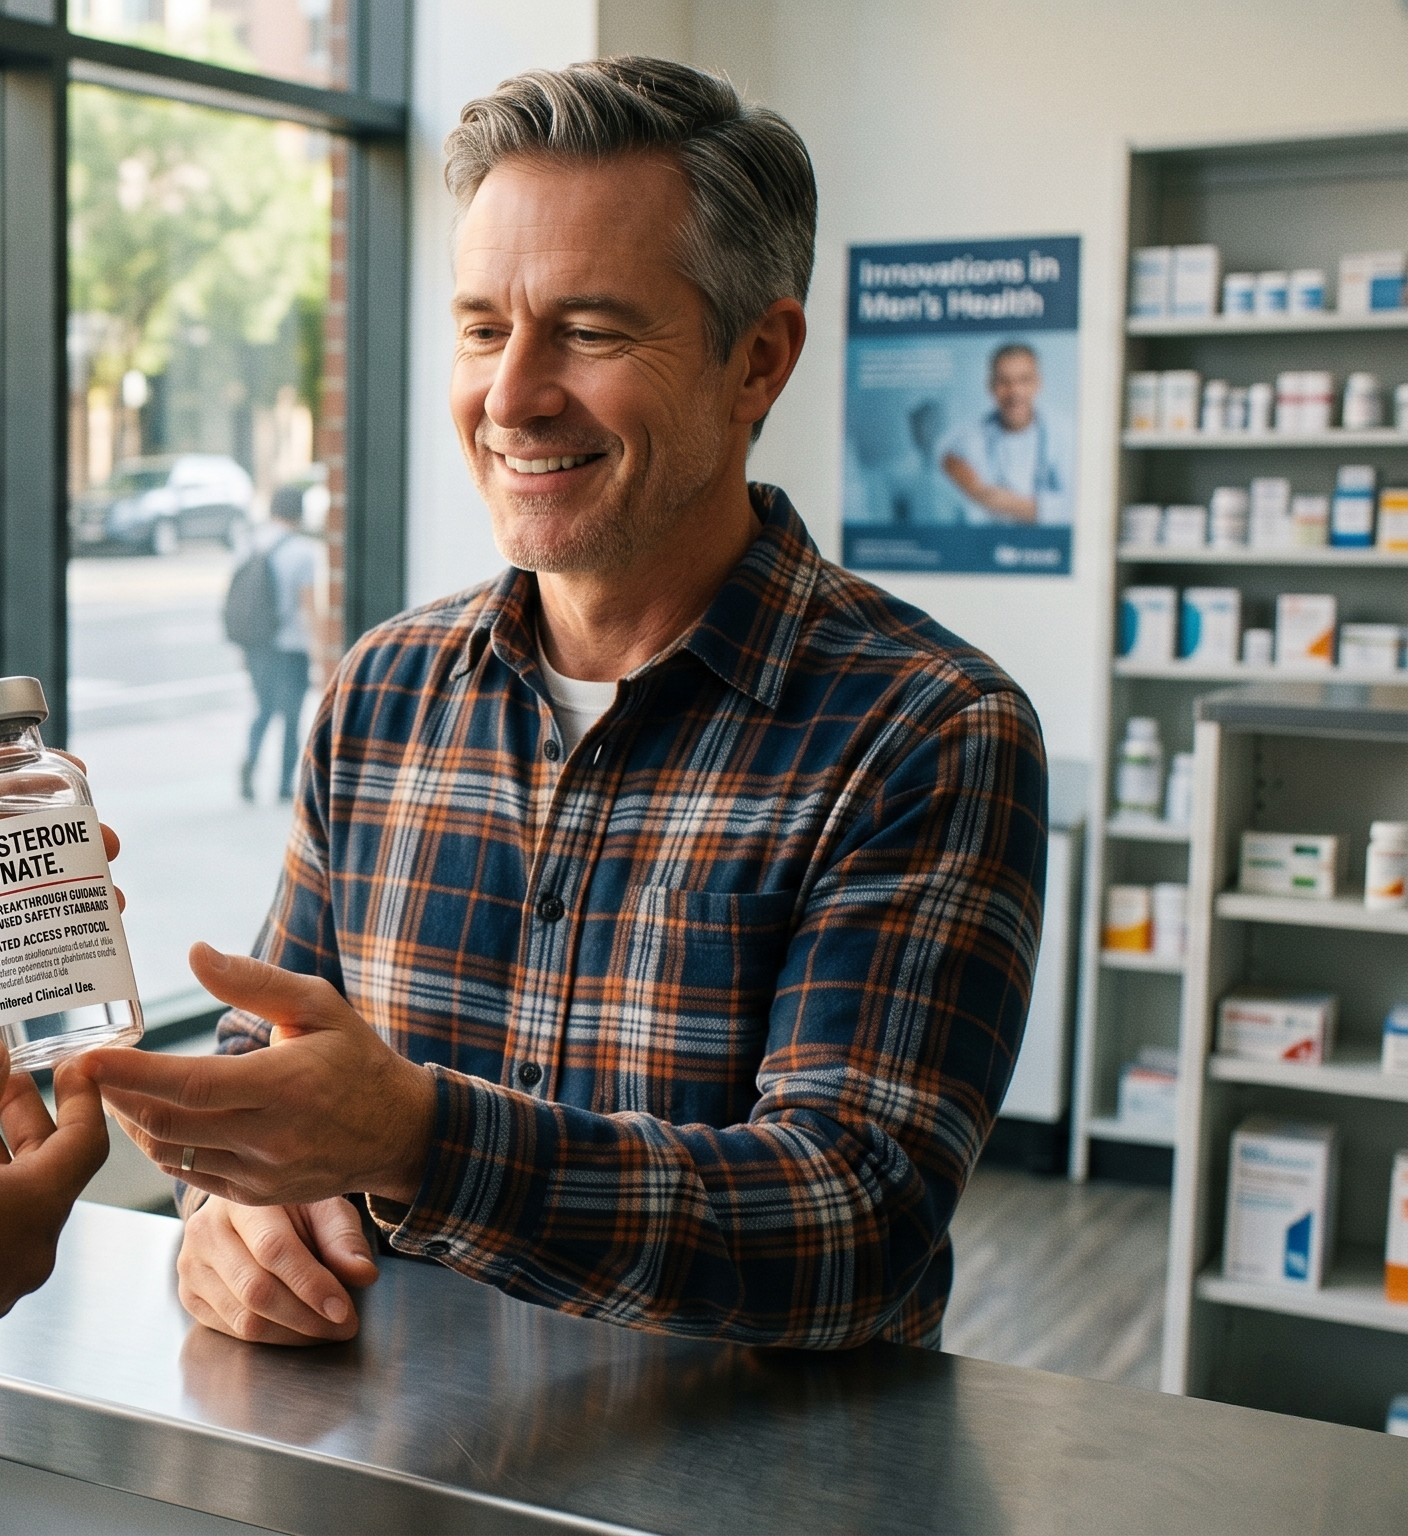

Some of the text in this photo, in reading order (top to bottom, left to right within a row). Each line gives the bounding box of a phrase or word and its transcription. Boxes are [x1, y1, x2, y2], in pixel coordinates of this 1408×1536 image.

[859, 250, 1060, 287] Innovations in
[859, 287, 1045, 321] Men's Health
[24, 906, 61, 923] SAFETY
[23, 928, 62, 946] ACCESS
[64, 921, 110, 937] PROTOCOL
[35, 983, 74, 1001] Clinical
